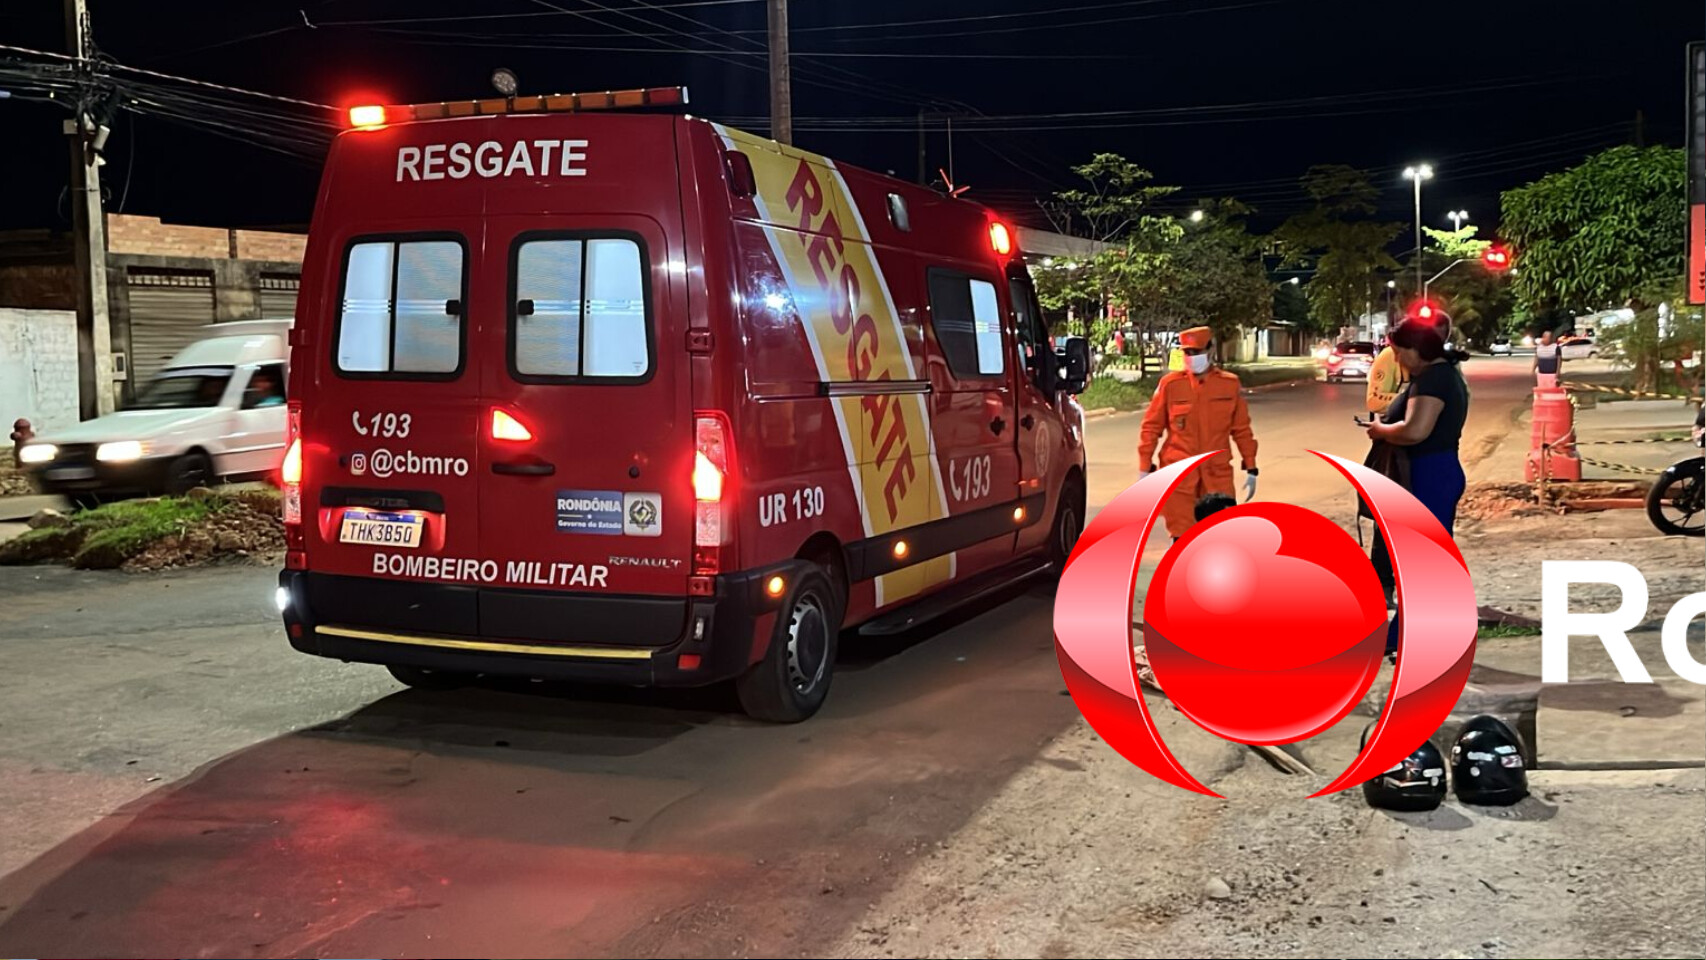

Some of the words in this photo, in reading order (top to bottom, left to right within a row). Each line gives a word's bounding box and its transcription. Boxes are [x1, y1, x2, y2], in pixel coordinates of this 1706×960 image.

[396, 139, 589, 182] RESGATE
[786, 158, 915, 524] RESGATE
[371, 413, 411, 438] 193
[371, 449, 469, 478] @cbmro
[963, 454, 992, 502] 193
[557, 497, 622, 512] RONDÔNIA
[759, 493, 787, 527] UR
[792, 485, 825, 520] 130
[373, 553, 499, 582] BOMBEIRO
[506, 561, 609, 588] MILITAR
[609, 556, 682, 569] RENAULT
